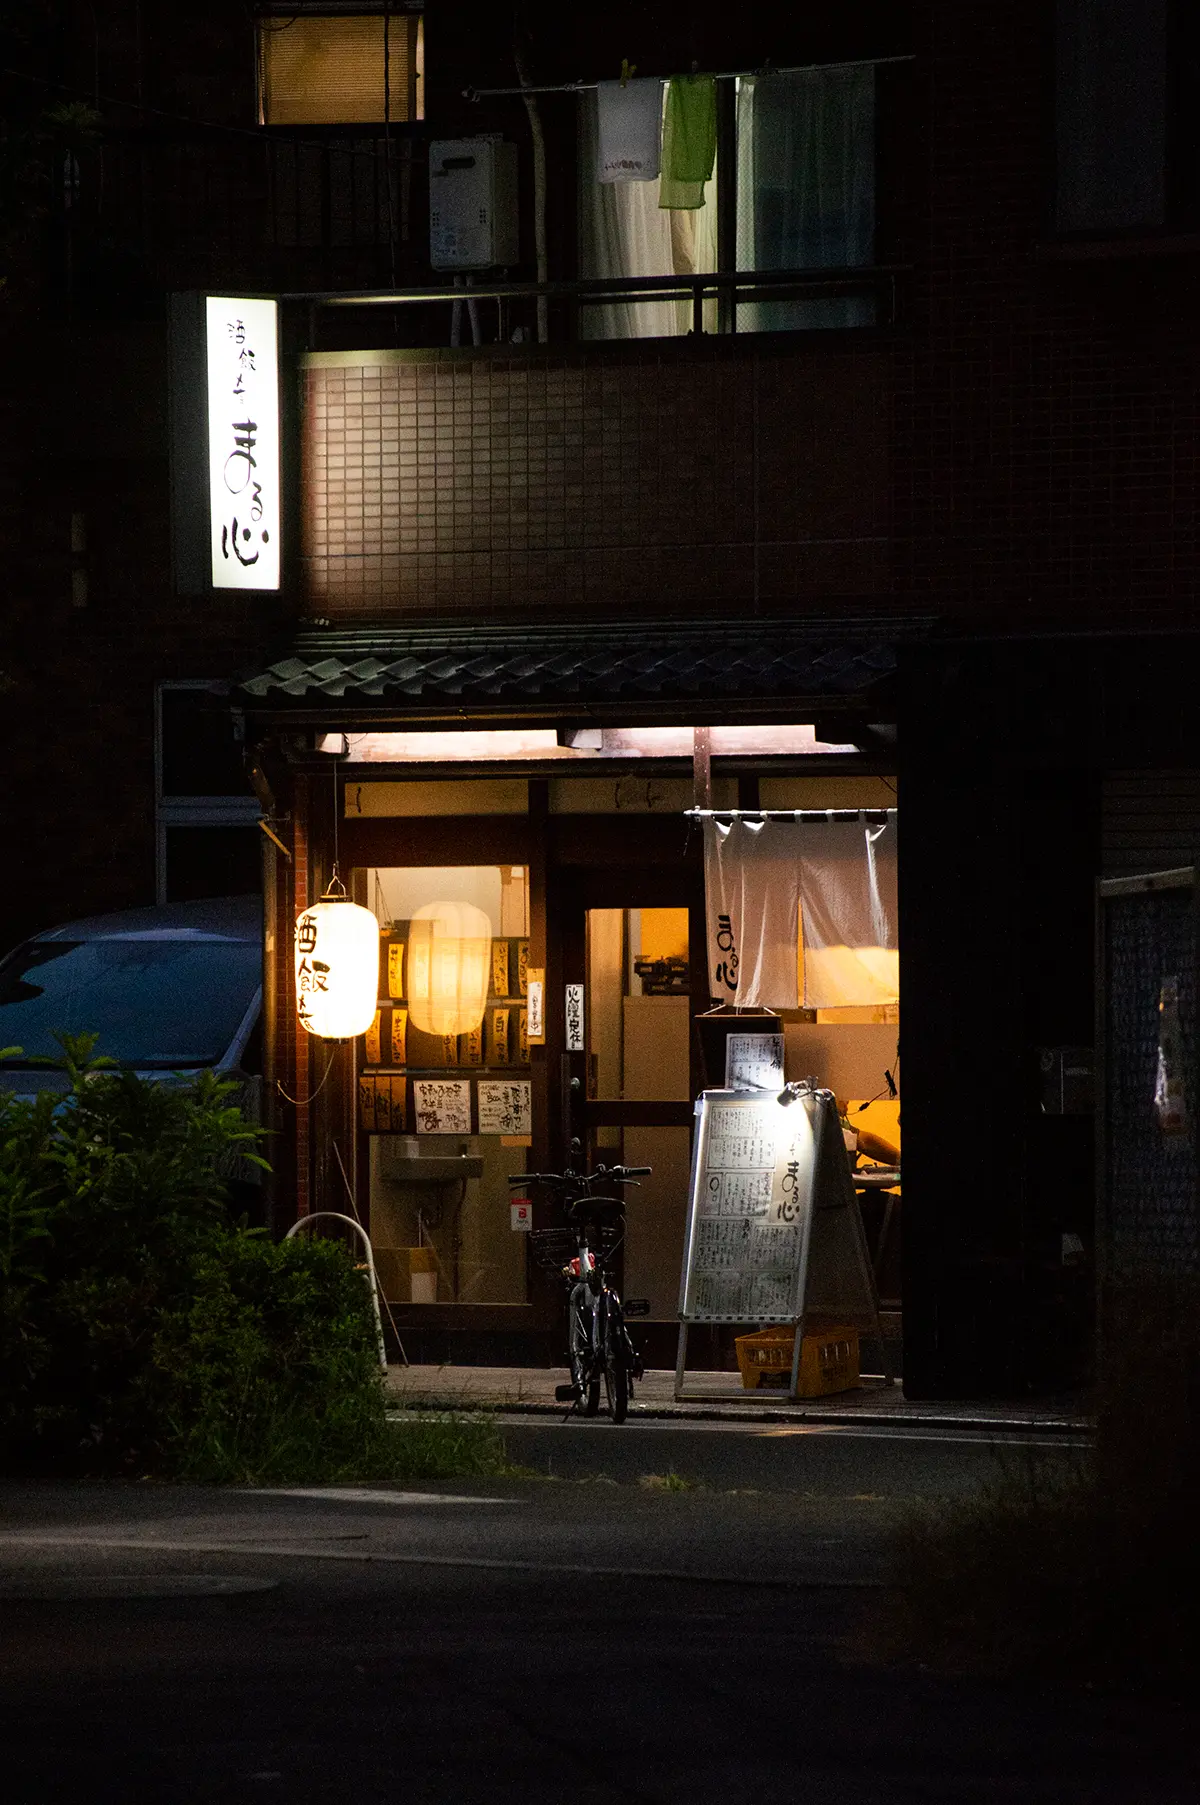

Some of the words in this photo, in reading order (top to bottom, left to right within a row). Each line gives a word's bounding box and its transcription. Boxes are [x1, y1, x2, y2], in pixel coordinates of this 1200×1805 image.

[221, 416, 270, 568] まる心
[776, 1159, 801, 1223] まる心
